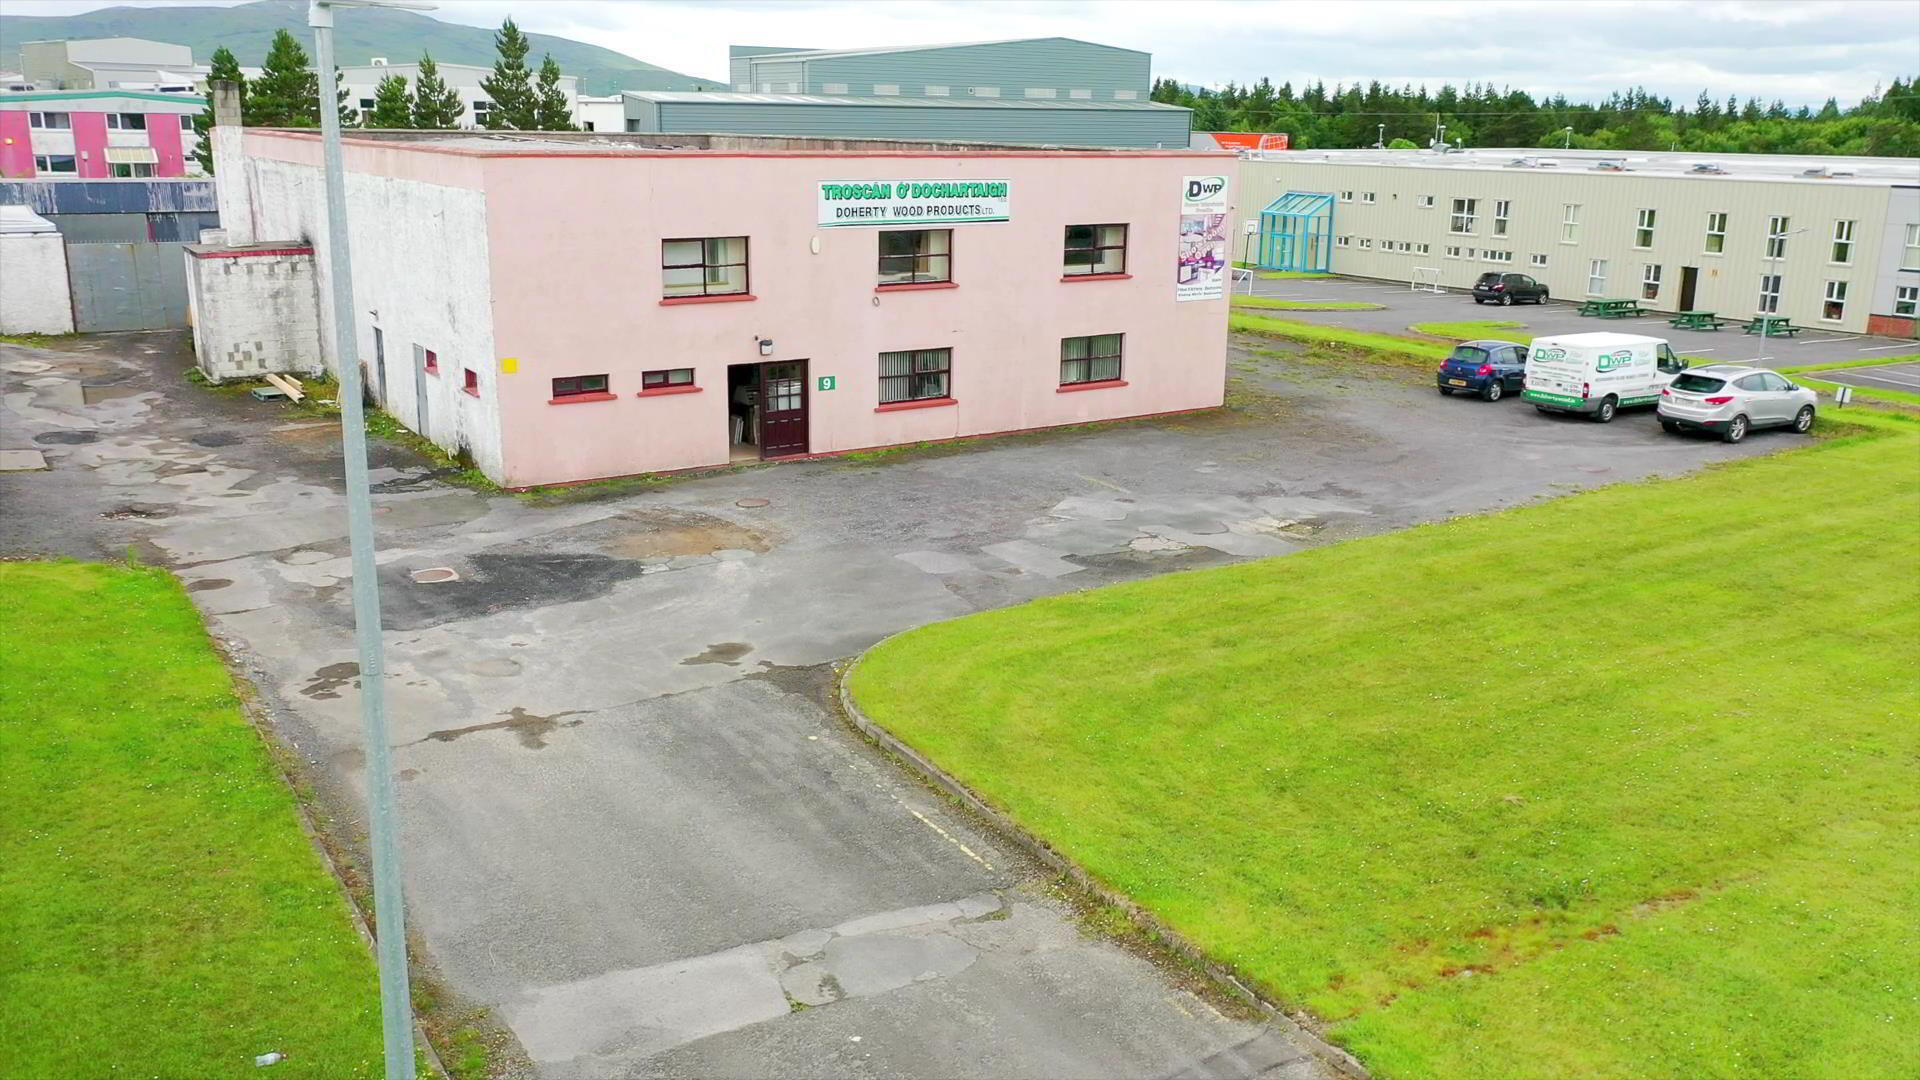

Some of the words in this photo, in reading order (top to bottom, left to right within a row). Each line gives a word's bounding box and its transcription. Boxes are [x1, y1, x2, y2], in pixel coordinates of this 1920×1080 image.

[836, 207, 887, 218] DOHERTY
[893, 205, 924, 217] WOOD
[926, 204, 981, 216] PRODUCTS
[1599, 354, 1632, 369] DWP
[823, 377, 831, 390] 9
